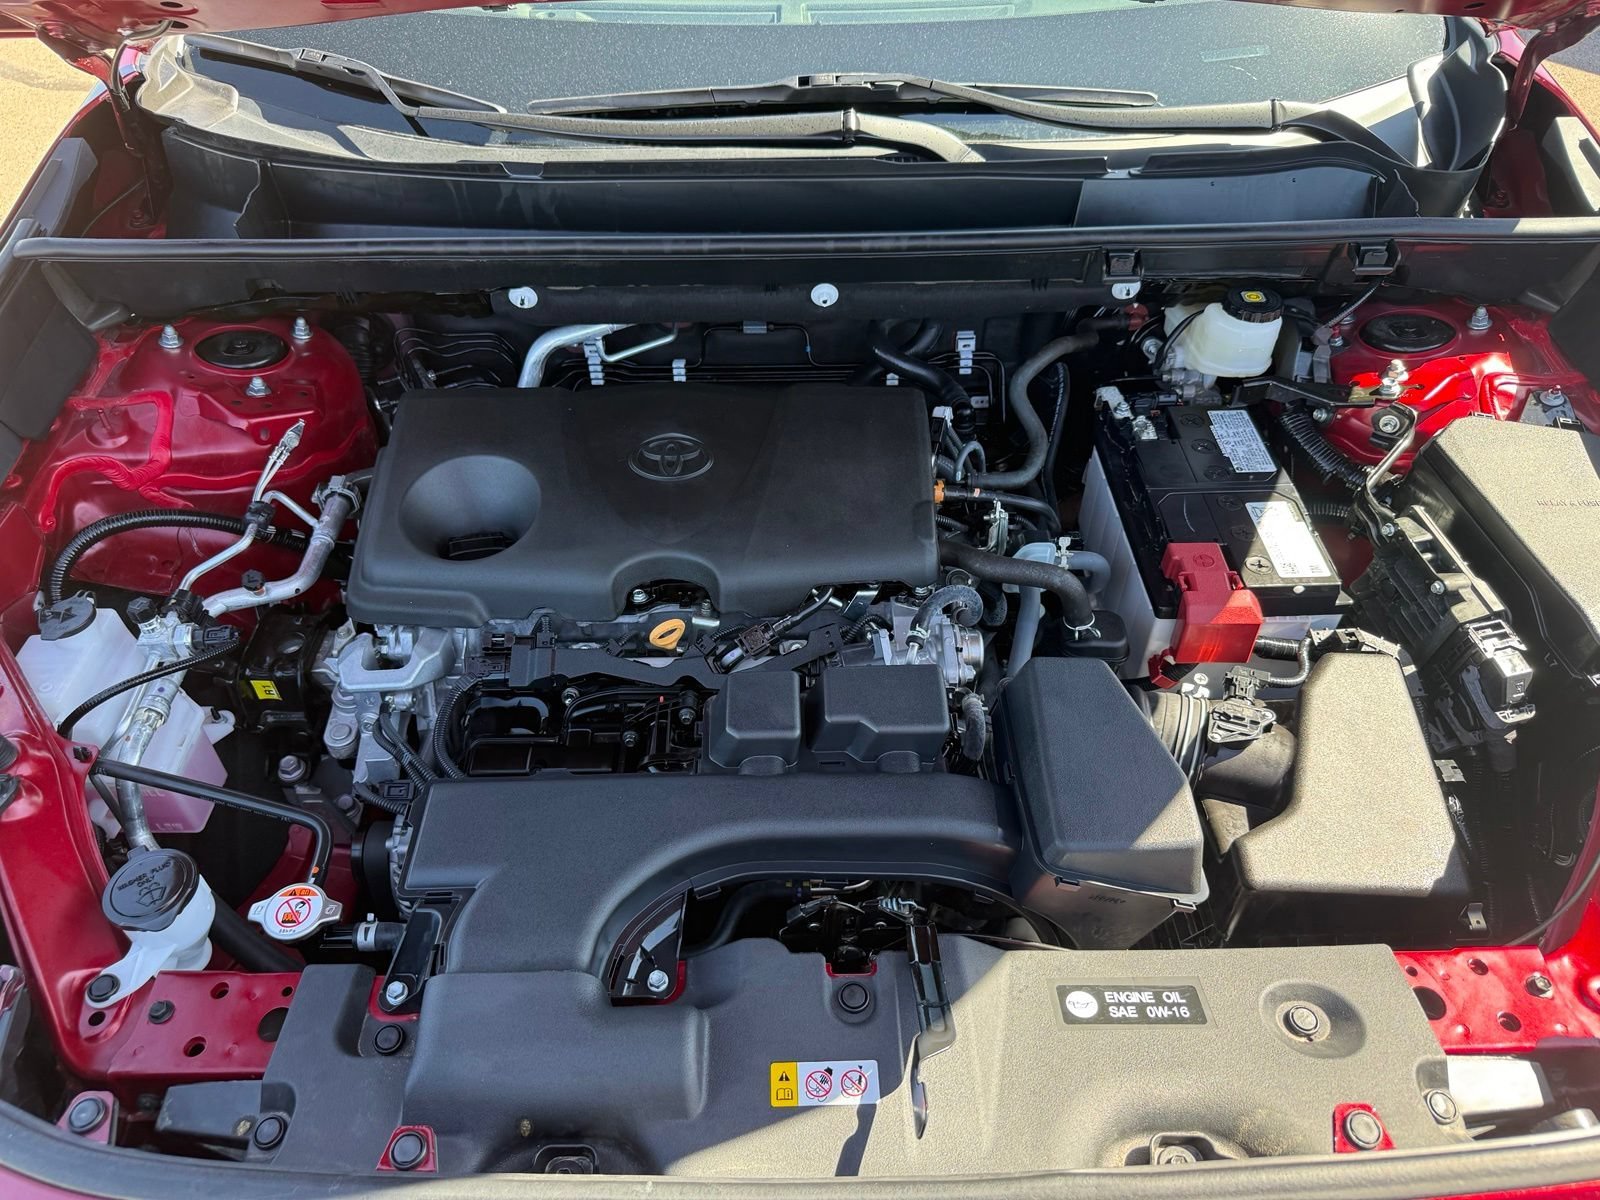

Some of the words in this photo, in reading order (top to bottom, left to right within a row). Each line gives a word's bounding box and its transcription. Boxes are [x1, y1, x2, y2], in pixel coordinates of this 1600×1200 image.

[1104, 991, 1156, 1003] ENGINE
[1162, 991, 1187, 1003] OIL
[1108, 1006, 1139, 1018] SAE
[1146, 1006, 1190, 1018] 0W-16
